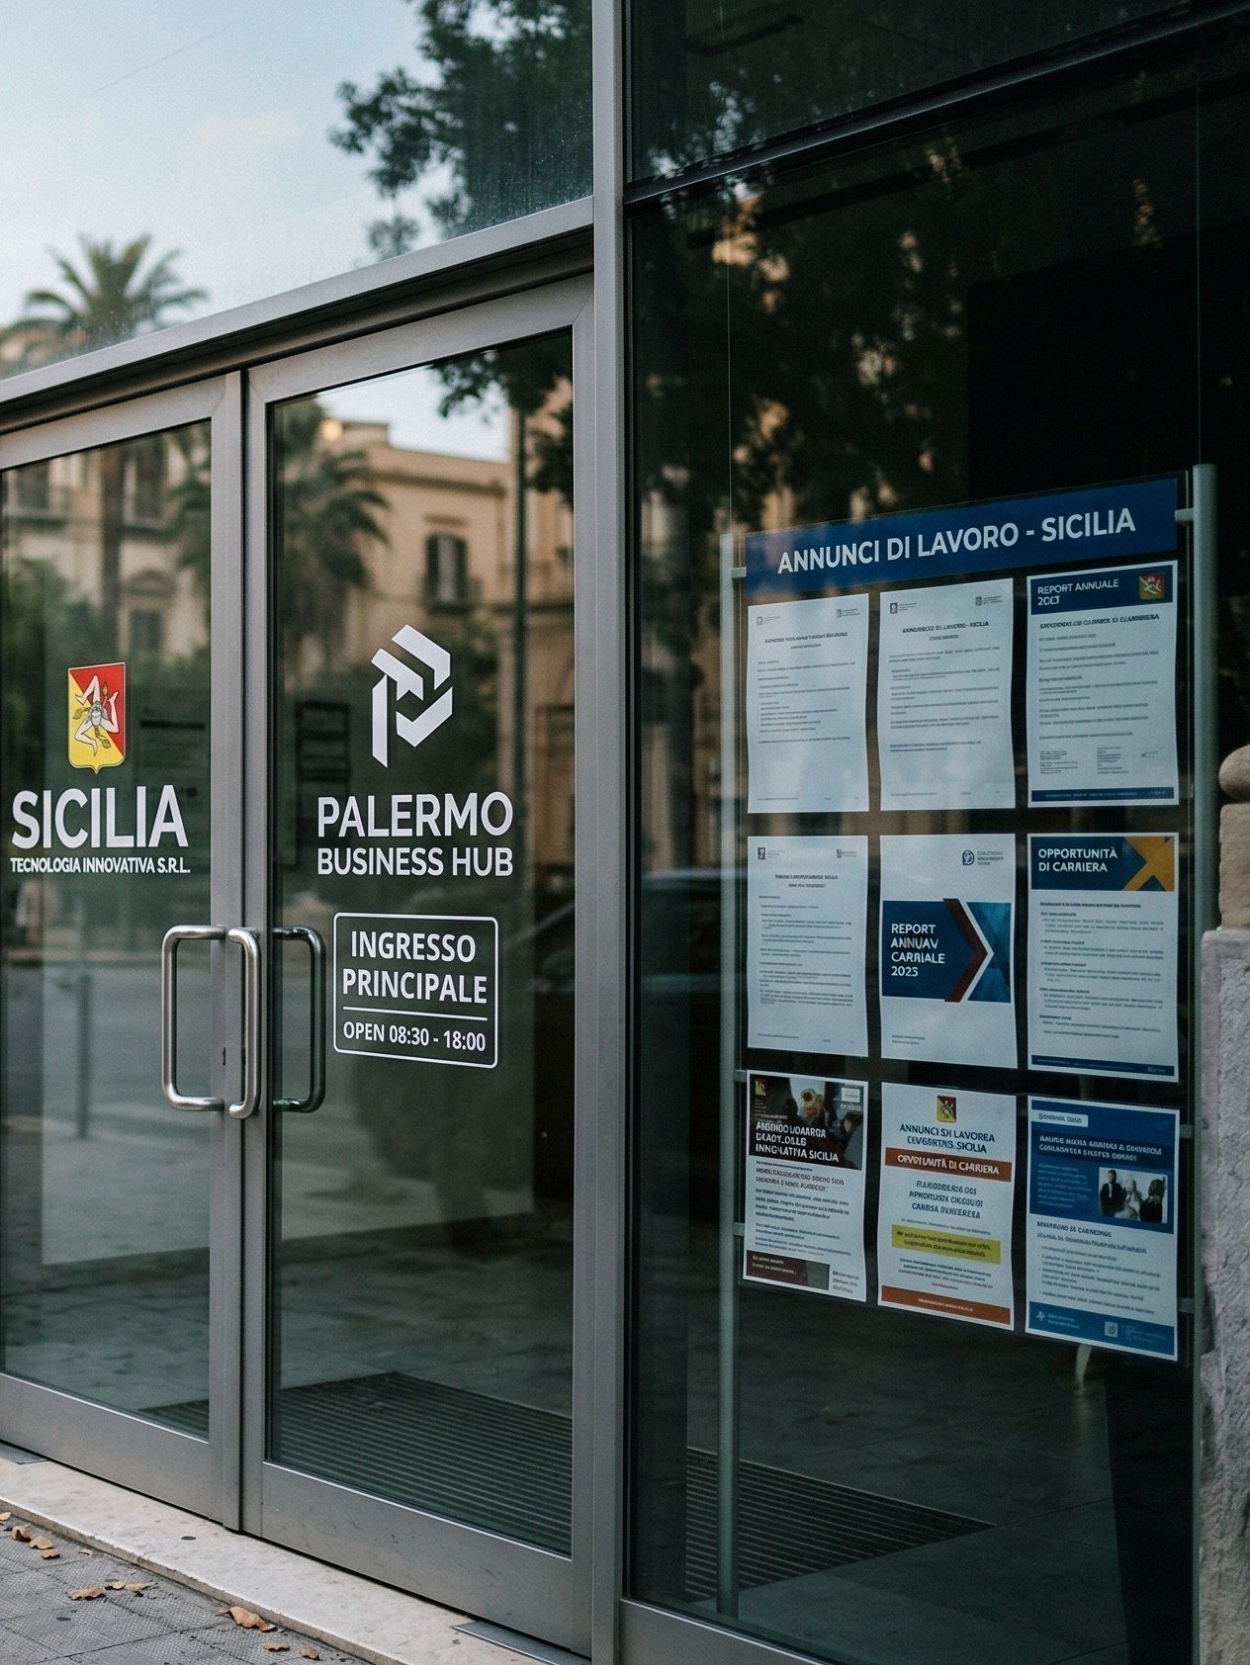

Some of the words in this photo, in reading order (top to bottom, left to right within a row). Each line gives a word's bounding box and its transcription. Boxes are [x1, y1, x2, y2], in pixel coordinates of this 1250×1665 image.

[777, 540, 880, 574] ANNUNCI
[887, 536, 910, 561] DI
[918, 522, 1019, 558] LAVORO
[1041, 507, 1137, 542] SICILIA
[1037, 583, 1074, 595] REPORT
[1074, 578, 1120, 592] ANNUALE
[11, 784, 189, 849] SICILIA
[317, 791, 514, 837] PALERMO
[10, 857, 81, 873] TECNOLOGIA
[83, 857, 155, 873] INNOVATIVA
[157, 857, 191, 873] S.R.L.
[317, 847, 444, 876] BUSINESS
[452, 847, 514, 877] HUB
[1038, 846, 1119, 859] OPPORTUNITÀ
[1038, 861, 1050, 872] DI
[891, 923, 936, 935] REPORT
[351, 930, 476, 963] INGRESSO
[342, 968, 488, 1004] PRINCIPALE
[343, 1021, 385, 1042] OPEN
[389, 1025, 430, 1046] 08:30
[443, 1030, 486, 1051] 18:00
[899, 1123, 940, 1136] ANNUNCI
